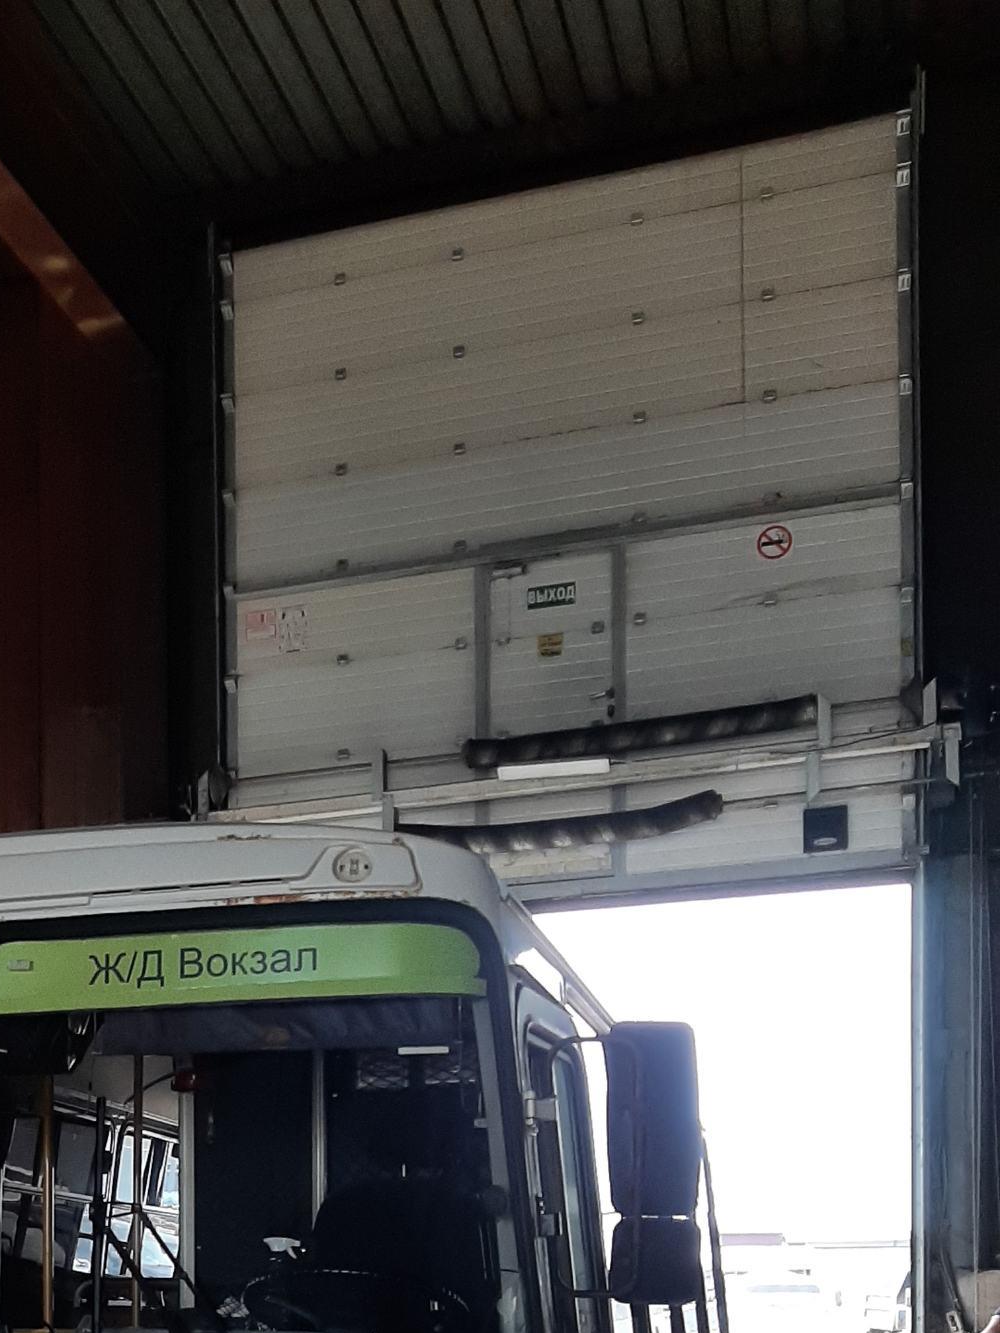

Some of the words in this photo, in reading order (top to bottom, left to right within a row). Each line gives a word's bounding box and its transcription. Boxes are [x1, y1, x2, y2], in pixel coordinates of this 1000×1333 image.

[528, 585, 575, 604] ВЫХОД
[89, 950, 164, 988] Ж/Д
[180, 948, 317, 979] Вокзал
